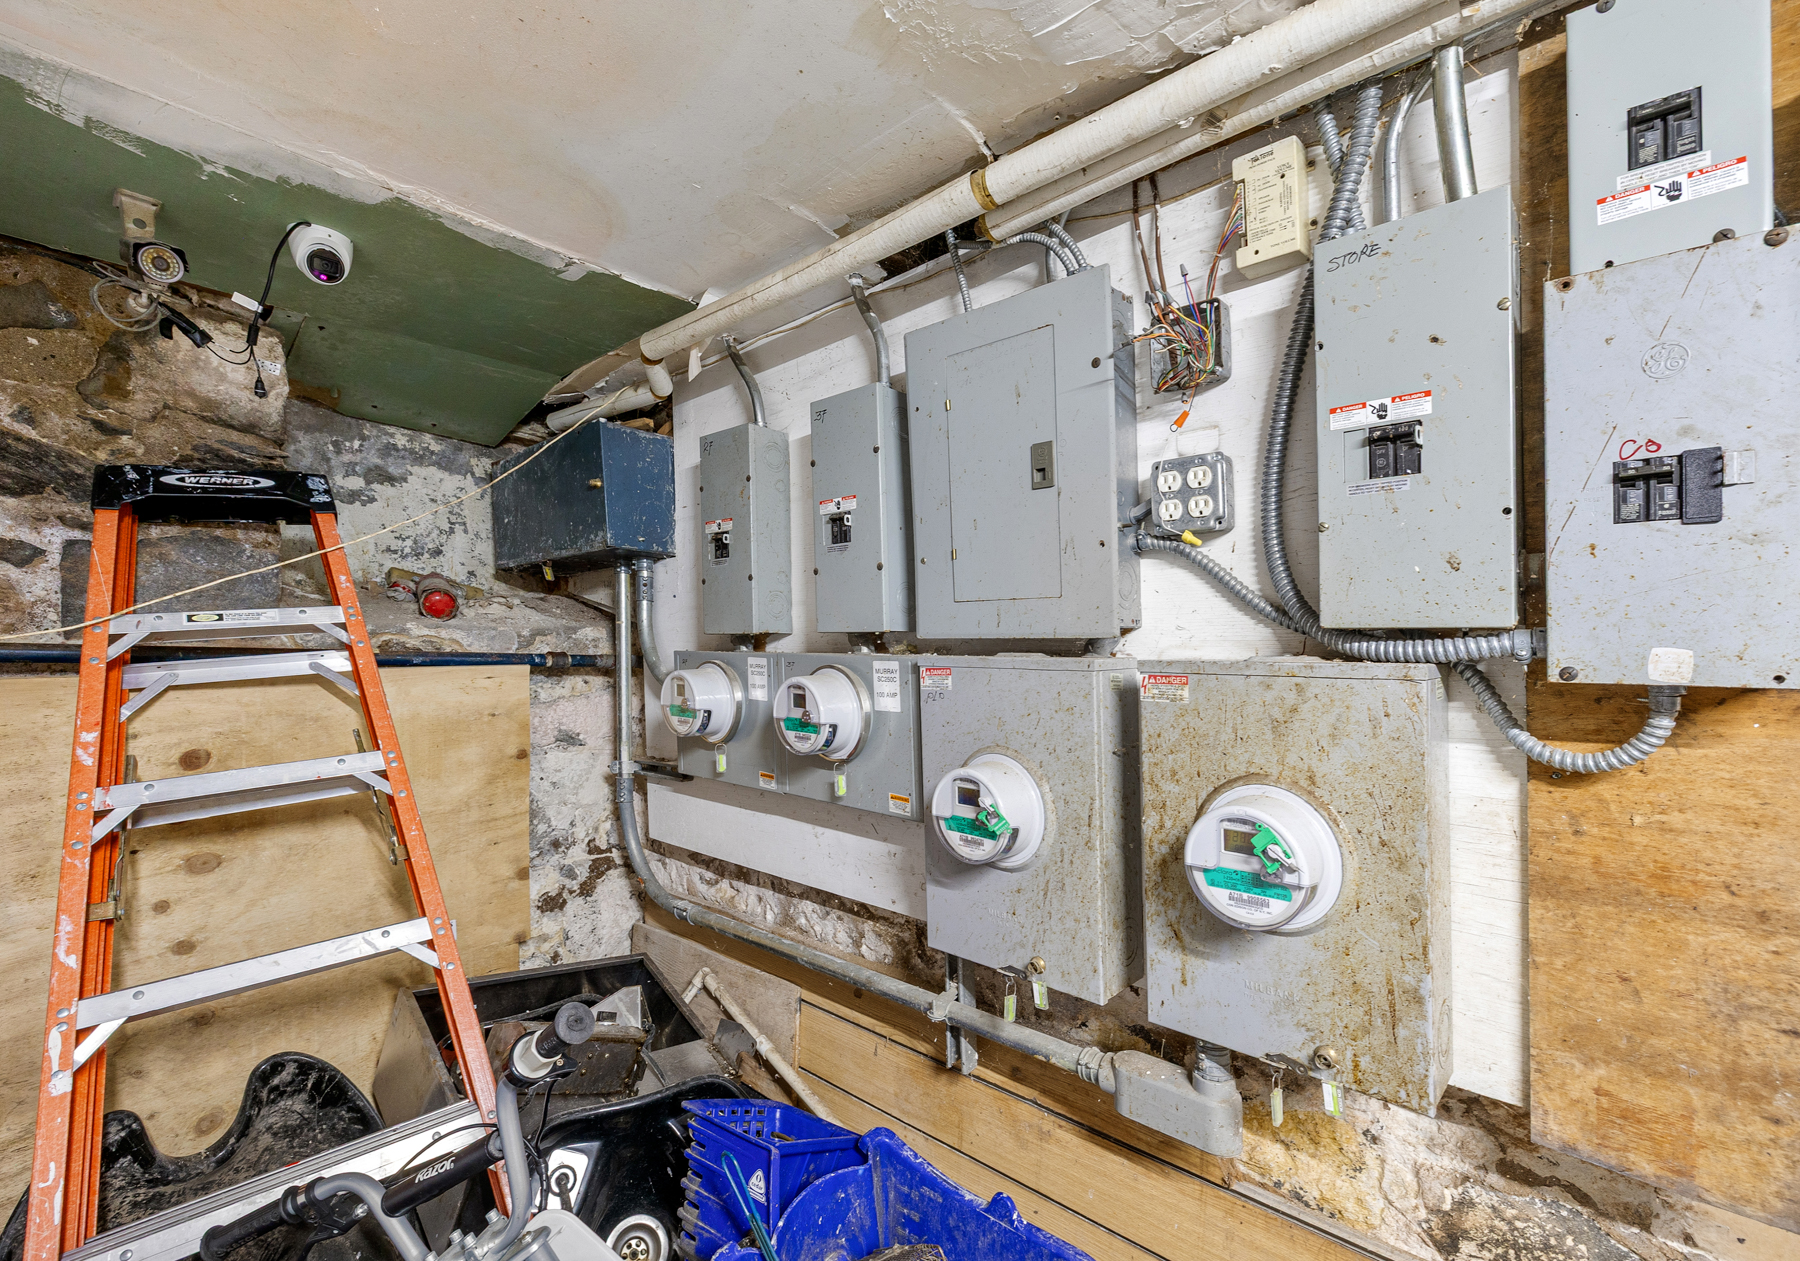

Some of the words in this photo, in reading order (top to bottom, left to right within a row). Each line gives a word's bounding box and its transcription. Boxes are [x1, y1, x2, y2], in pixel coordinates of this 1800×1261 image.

[1703, 160, 1737, 173] PELIGRO
[1615, 187, 1645, 198] DANGER
[1327, 244, 1381, 272] STORE
[184, 476, 254, 485] WERNER
[1157, 676, 1186, 684] DANGER
[1244, 979, 1300, 1002] MILBANK
